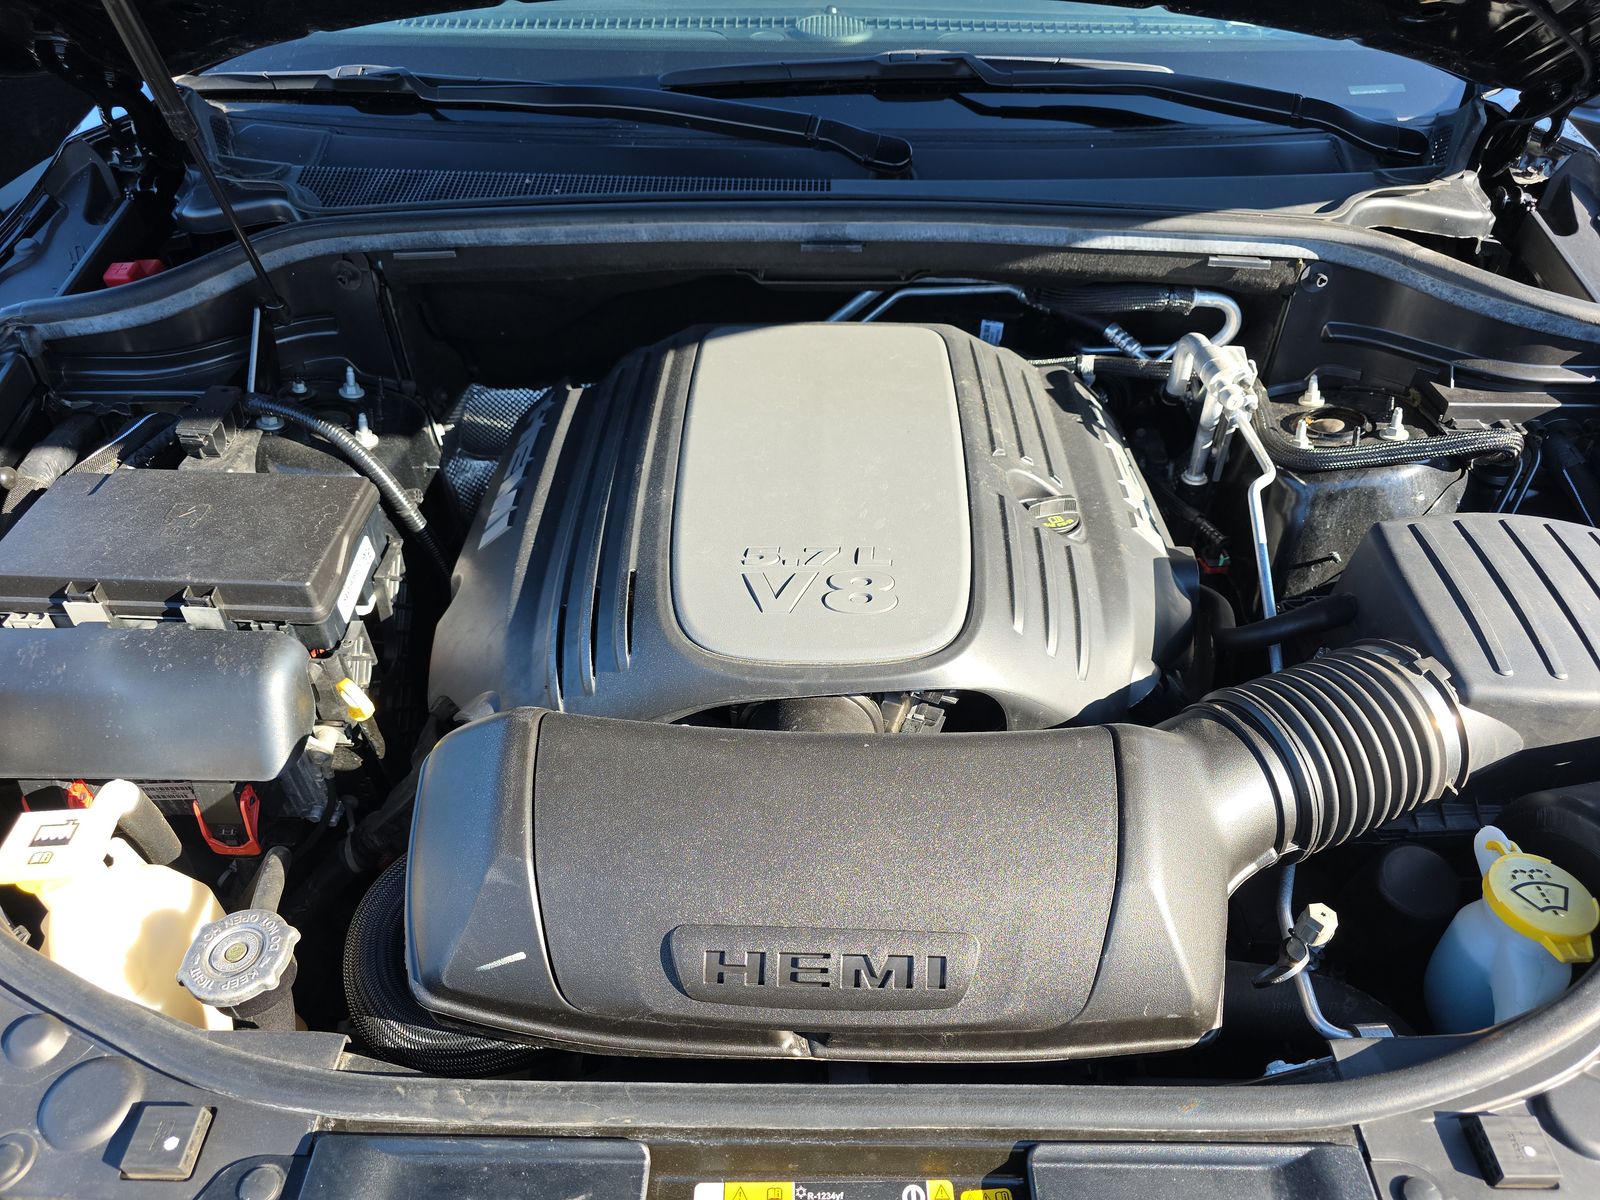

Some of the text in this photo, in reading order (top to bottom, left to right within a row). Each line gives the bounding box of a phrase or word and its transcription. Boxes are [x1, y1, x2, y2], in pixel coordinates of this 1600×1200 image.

[740, 545, 893, 567] 5.7L
[740, 570, 899, 615] V8
[223, 913, 260, 929] OPEN
[261, 917, 280, 937] NOT
[269, 938, 282, 952] DO
[189, 967, 260, 991] KEEP TIGHT
[703, 950, 947, 990] HEMI
[807, 1191, 844, 1200] R-1234yf
